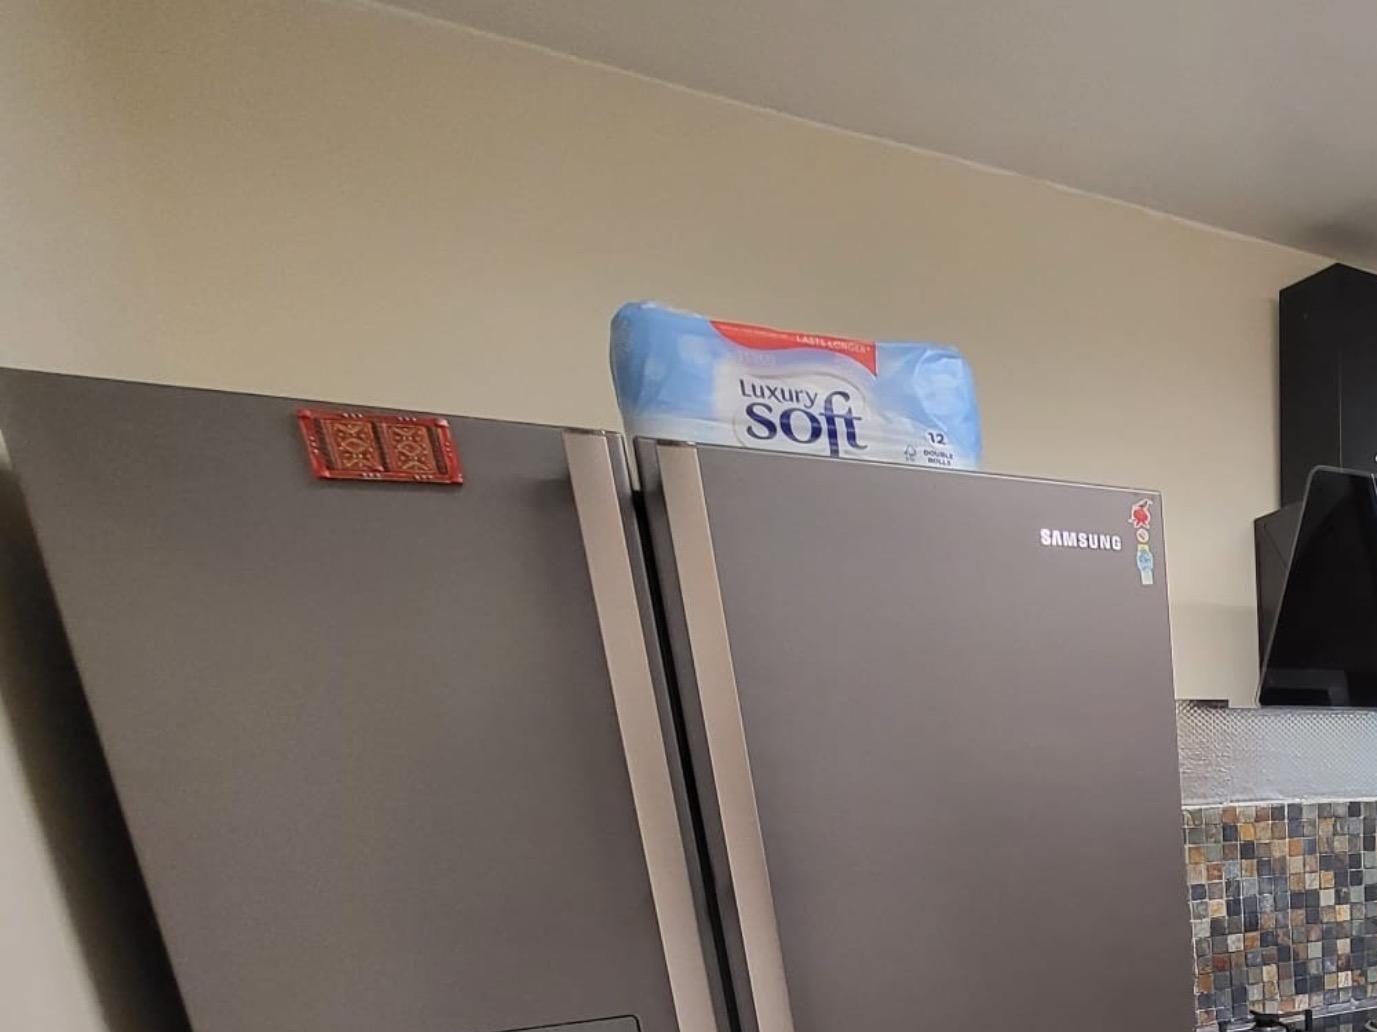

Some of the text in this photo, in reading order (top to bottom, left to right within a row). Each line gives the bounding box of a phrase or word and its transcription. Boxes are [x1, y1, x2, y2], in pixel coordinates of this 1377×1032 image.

[740, 379, 818, 409] Luxury
[928, 432, 946, 445] 12
[923, 449, 953, 460] DOUBLE
[1040, 528, 1122, 551] SAMSUNG
